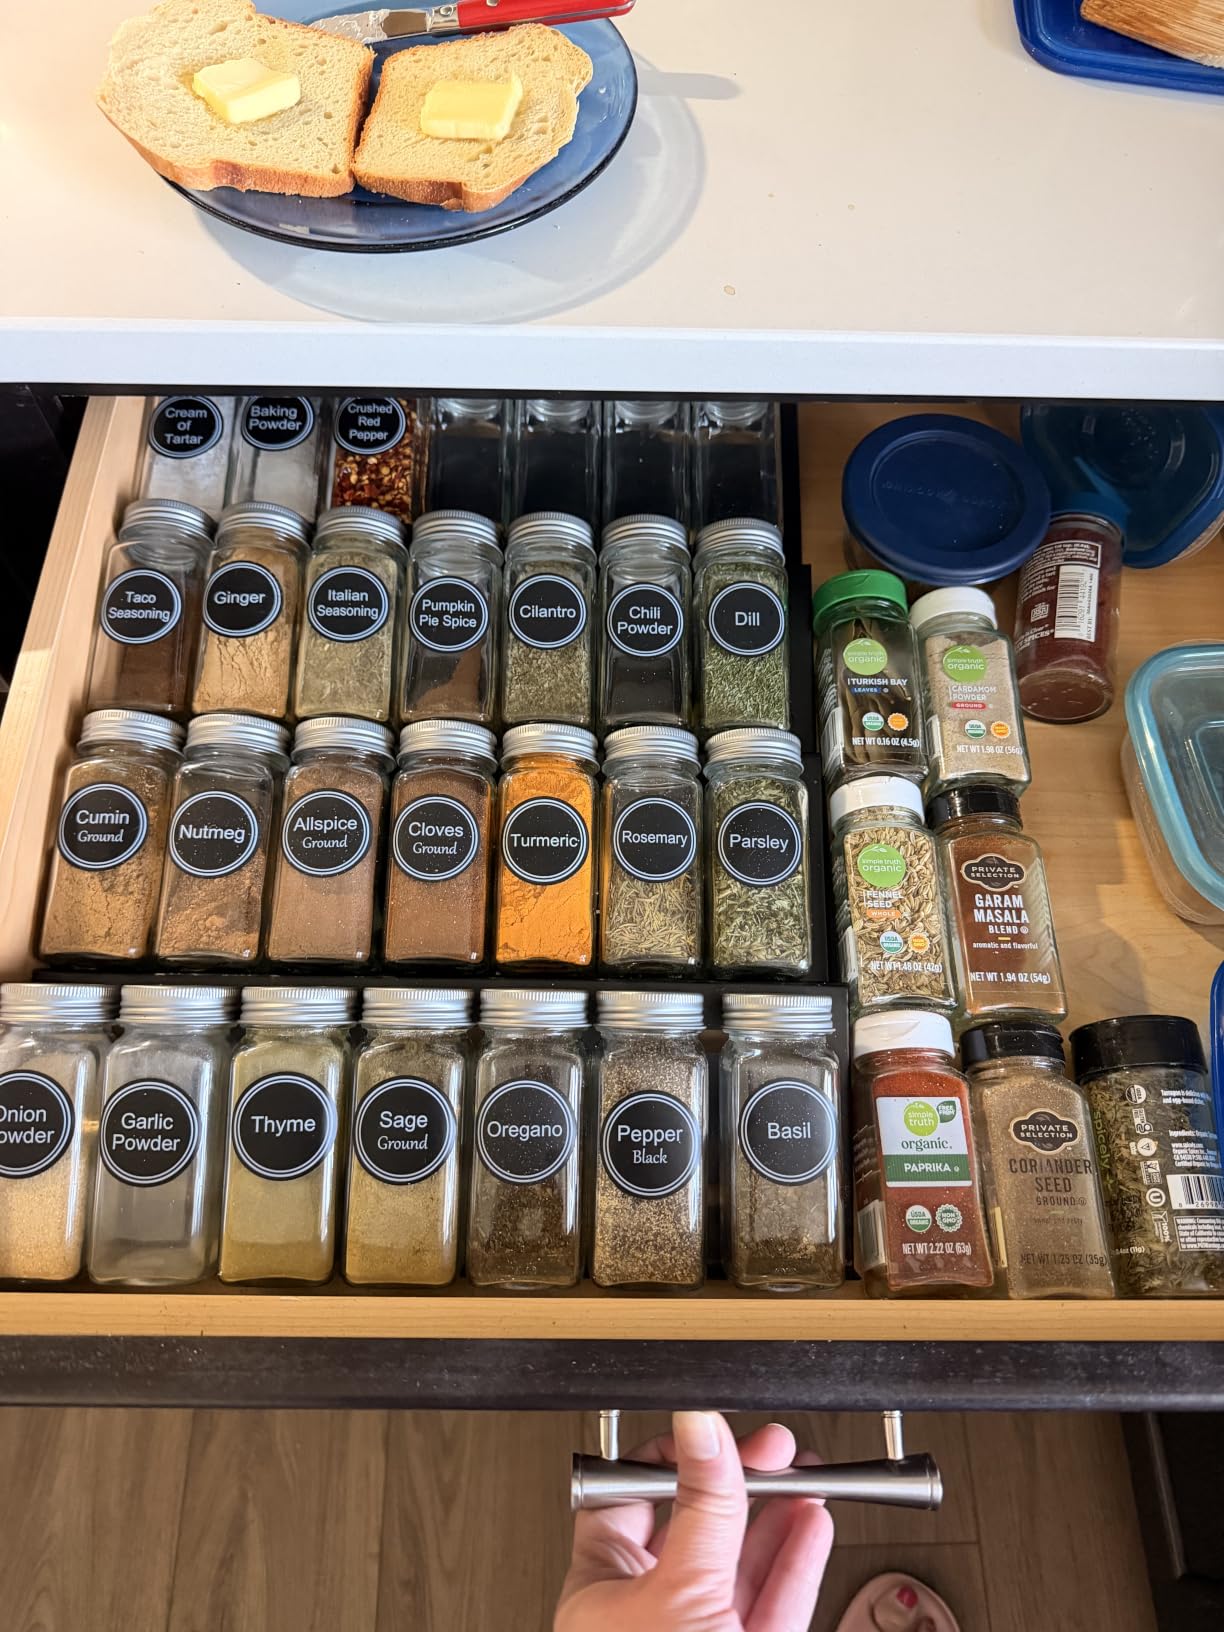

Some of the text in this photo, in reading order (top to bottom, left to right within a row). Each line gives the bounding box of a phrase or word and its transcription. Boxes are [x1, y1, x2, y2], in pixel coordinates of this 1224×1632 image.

[165, 407, 207, 420] Cream
[250, 406, 298, 420] Baking
[347, 402, 393, 414] Crushed
[177, 418, 192, 431] of
[249, 418, 302, 431] Powder
[358, 416, 381, 427] Red
[164, 433, 204, 446] Tartar
[348, 429, 389, 442] Pepper
[125, 591, 157, 604] Taco
[213, 590, 266, 608] Ginger
[327, 588, 369, 603] Italian
[316, 603, 380, 621] Seasoning
[421, 598, 475, 615] Pumpkin
[519, 604, 577, 619] Cilantro
[628, 605, 662, 620] Chili
[107, 606, 171, 623] Seasoning
[734, 611, 761, 627] Dill
[419, 614, 477, 631] Pie Spice
[616, 620, 674, 636] Powder
[848, 656, 884, 664] organic
[947, 663, 985, 671] organic
[851, 678, 888, 686] TURKISH
[852, 737, 920, 748] NET WT 0.16 OZ (4.5g)
[957, 744, 969, 753] NET
[970, 745, 982, 753] WT
[995, 746, 1004, 754] OZ
[75, 809, 130, 825] Cumin
[293, 816, 358, 833] Allspice
[77, 828, 124, 844] Ground
[179, 823, 246, 844] Nutmeg
[408, 821, 464, 838] Cloves
[302, 834, 348, 850] Ground
[510, 832, 579, 849] Turmeric
[621, 829, 689, 849] Rosemary
[728, 834, 789, 854] Parsley
[412, 840, 457, 856] Ground
[862, 865, 902, 873] organic
[867, 890, 903, 899] FENNEL
[974, 893, 1024, 909] GARAM
[867, 900, 892, 908] SEED
[973, 909, 1030, 924] MASALA
[988, 925, 1018, 935] BLEND
[1012, 942, 1038, 950] flavorful
[871, 961, 885, 970] NET
[886, 961, 898, 971] WT
[912, 962, 923, 971] OZ
[924, 962, 943, 973] (42g)
[970, 972, 1051, 985] NET WT 1.94 OZ (54g)
[121, 1112, 174, 1131] Garlic
[379, 1110, 428, 1132] Sage
[908, 1111, 934, 1121] simple
[909, 1118, 935, 1127] truth
[251, 1115, 316, 1135] Thyme
[487, 1119, 563, 1141] Oregano
[767, 1122, 811, 1140] Basil
[1021, 1124, 1069, 1132] PRIVATE
[0, 1126, 55, 1144] owder
[377, 1134, 428, 1151] Ground
[617, 1125, 683, 1147] Pepper
[1093, 1110, 1111, 1169] spicely
[112, 1134, 181, 1152] Powder
[632, 1149, 668, 1166] Black
[904, 1163, 951, 1173] PAPRIKA
[1009, 1158, 1093, 1175] CORIANDER
[1035, 1177, 1072, 1193] SEED
[1036, 1196, 1076, 1206] GROUND
[1161, 1222, 1171, 1242] 100%
[902, 1243, 972, 1256] NET WT 2.22 OZ (63g)
[1021, 1253, 1107, 1267] NET WT 1.25 OZ (35g)
